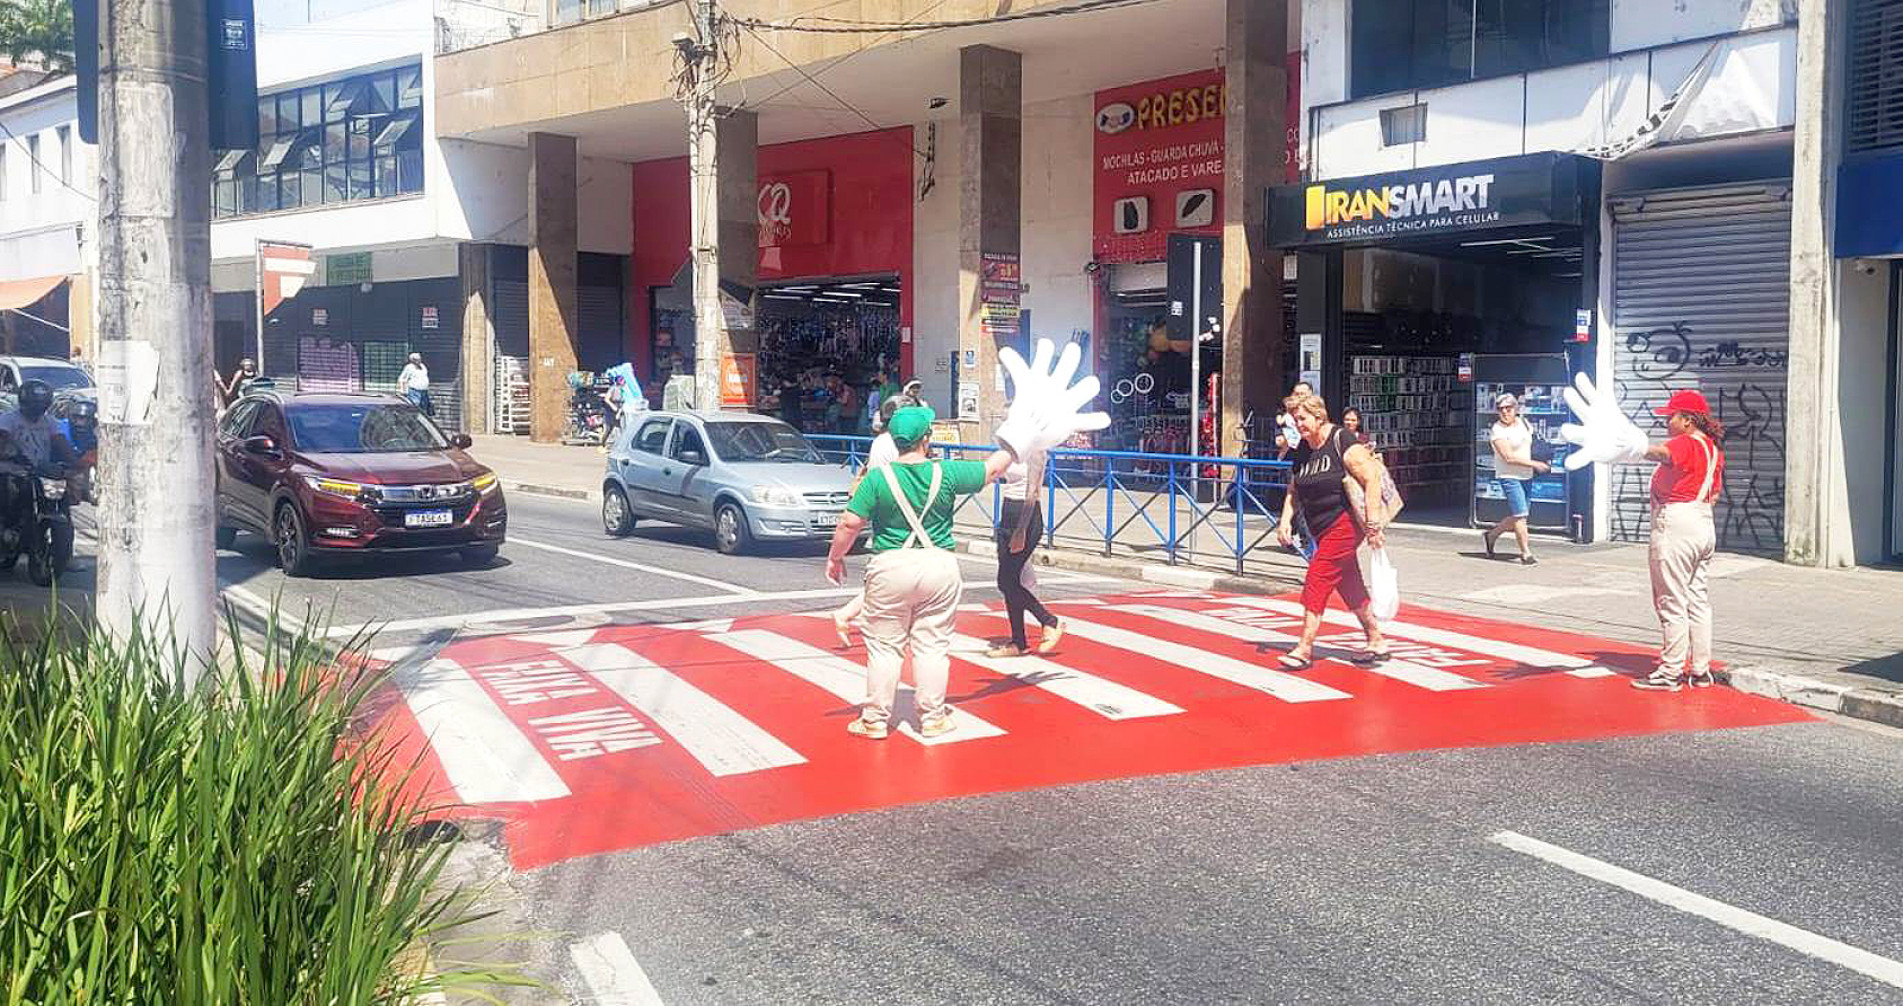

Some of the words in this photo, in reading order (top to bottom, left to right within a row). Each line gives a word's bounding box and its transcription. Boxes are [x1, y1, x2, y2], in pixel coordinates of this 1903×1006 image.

[1103, 151, 1145, 169] MOCHILAS
[1151, 145, 1188, 164] GUARDA
[1189, 139, 1220, 158] CHUVA
[1127, 165, 1178, 185] ATACADO
[1181, 165, 1189, 178] E
[1191, 160, 1226, 177] VARE
[1327, 223, 1384, 240] ASSISTÊNCIA
[1386, 220, 1427, 232] TÉCNICA
[1429, 216, 1453, 228] PARA
[1455, 211, 1500, 226] CELULAR
[473, 659, 599, 706] FAIXA
[528, 704, 664, 762] VIVA
